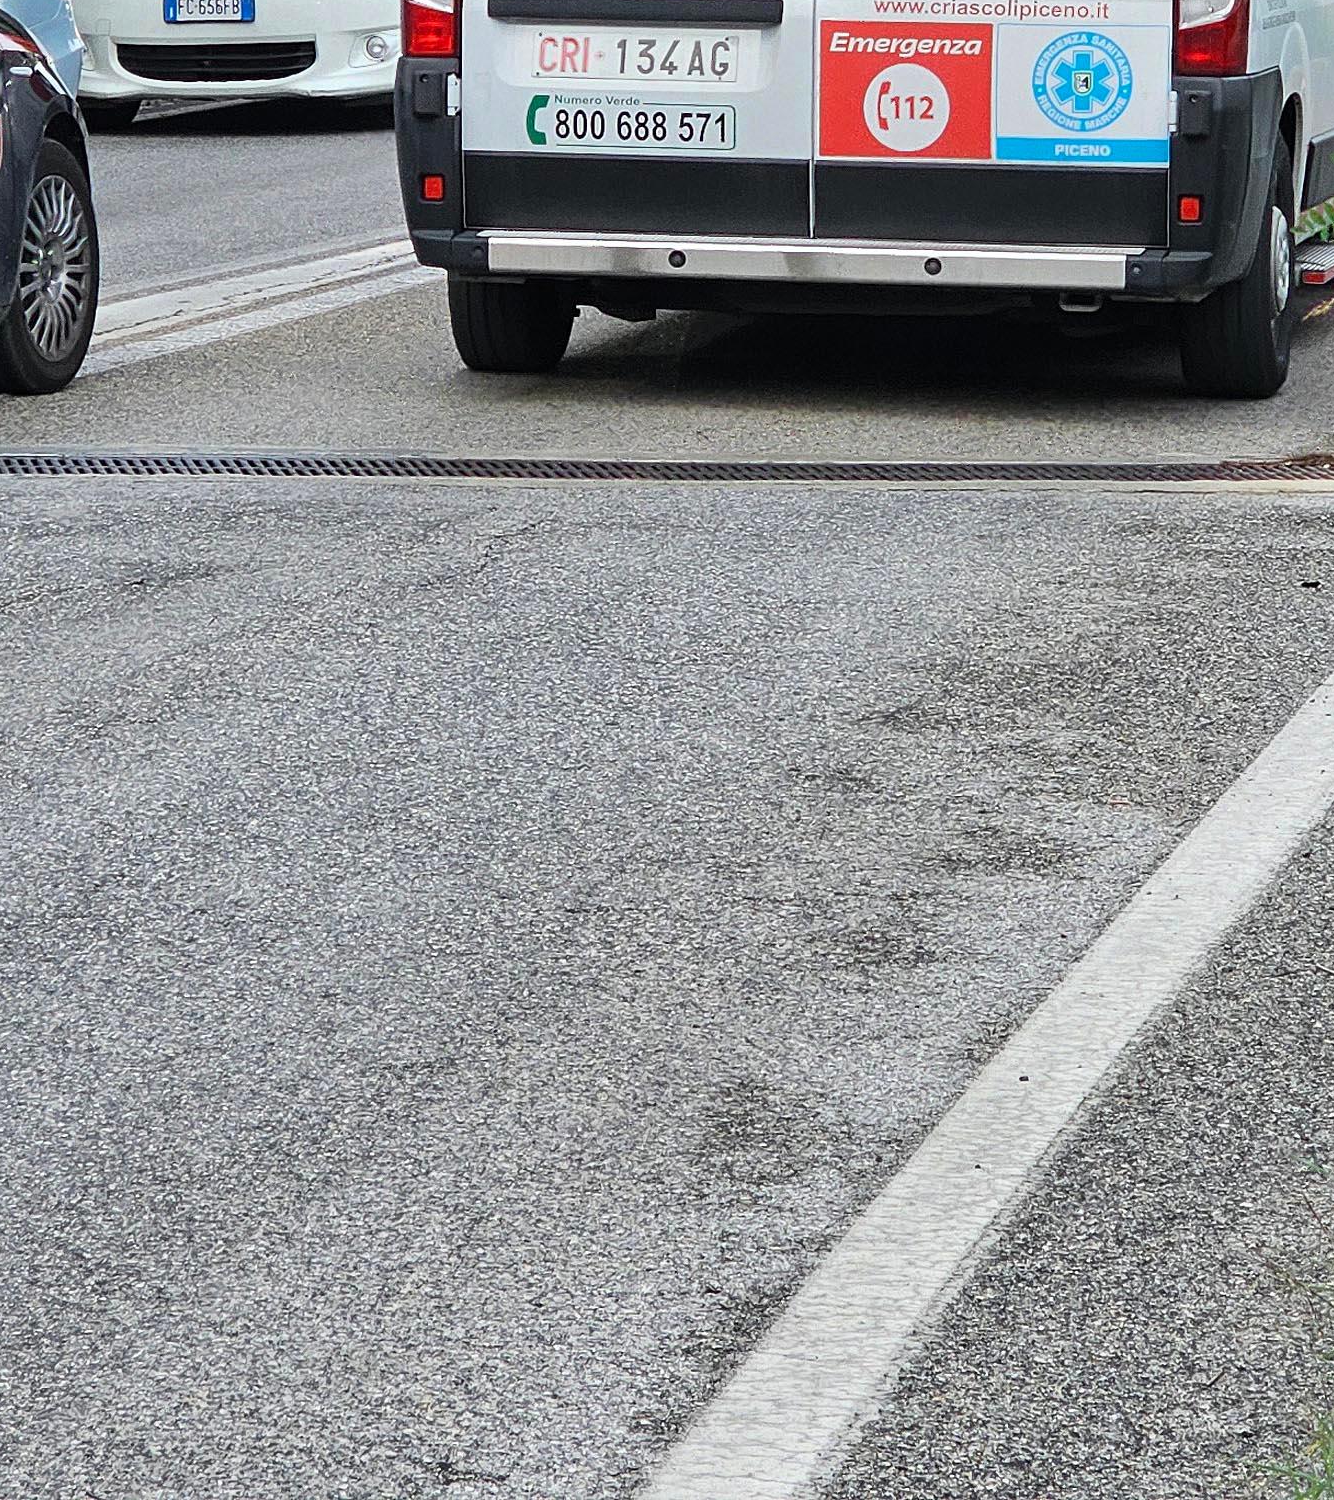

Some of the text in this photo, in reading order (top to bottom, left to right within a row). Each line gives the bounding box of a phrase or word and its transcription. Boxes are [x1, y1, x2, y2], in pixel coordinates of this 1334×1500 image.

[874, 0, 1110, 21] www.criascolipiceno.it
[538, 36, 591, 74] CRI
[829, 32, 983, 58] Emergenza
[554, 95, 640, 106] Numero Verde
[890, 95, 935, 120] 112
[555, 109, 727, 143] 800 688 571
[1054, 143, 1112, 157] PICENO
